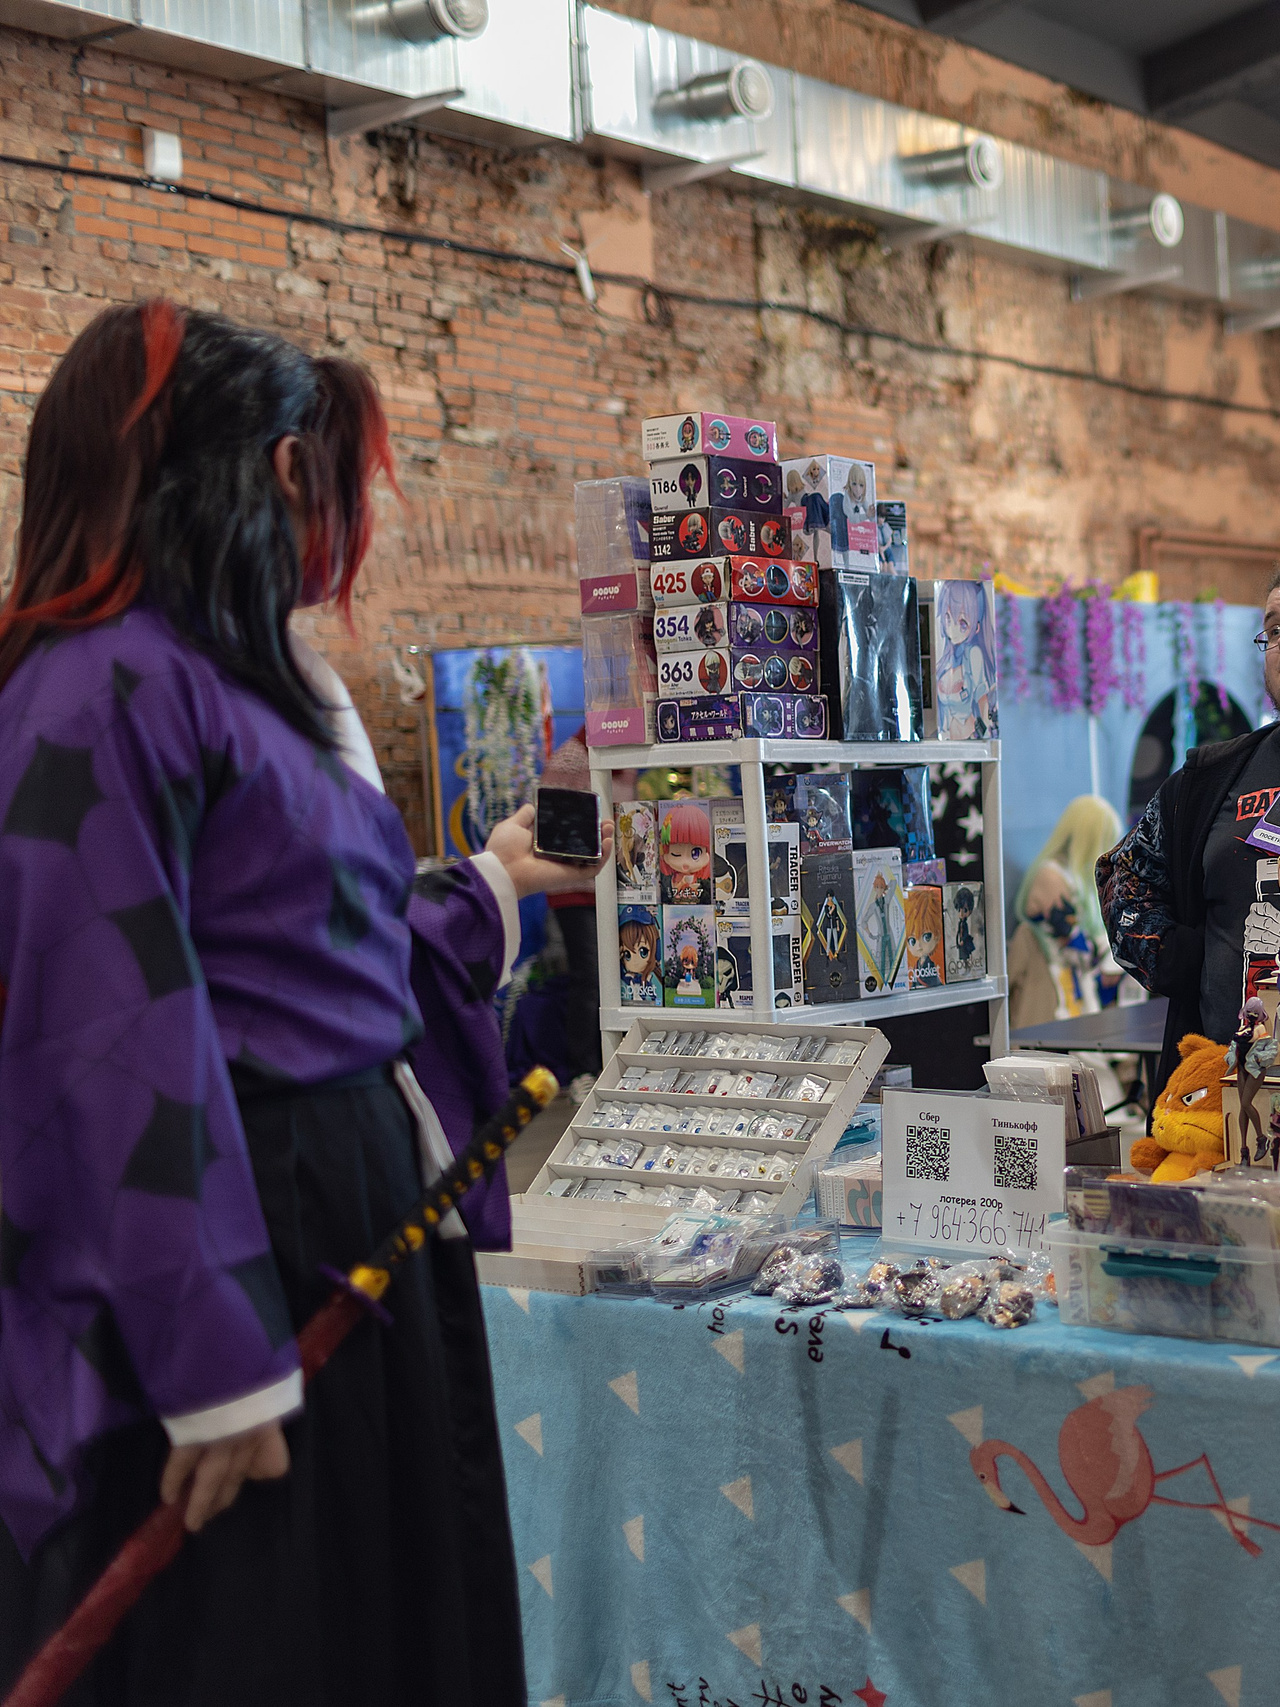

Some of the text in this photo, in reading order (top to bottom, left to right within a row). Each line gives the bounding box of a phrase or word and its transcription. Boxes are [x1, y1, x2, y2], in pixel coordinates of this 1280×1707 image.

[652, 480, 678, 495] 1186
[653, 515, 676, 525] Saber
[653, 544, 672, 556] 1142
[653, 572, 687, 595] 425
[655, 615, 690, 638] 354
[660, 660, 693, 684] 363
[789, 845, 799, 892] TRACER
[792, 937, 802, 984] REAPER
[919, 1111, 941, 1124] Сбер
[991, 1118, 1039, 1133] Тинькофф
[939, 1194, 1004, 1211] лотерея 200р
